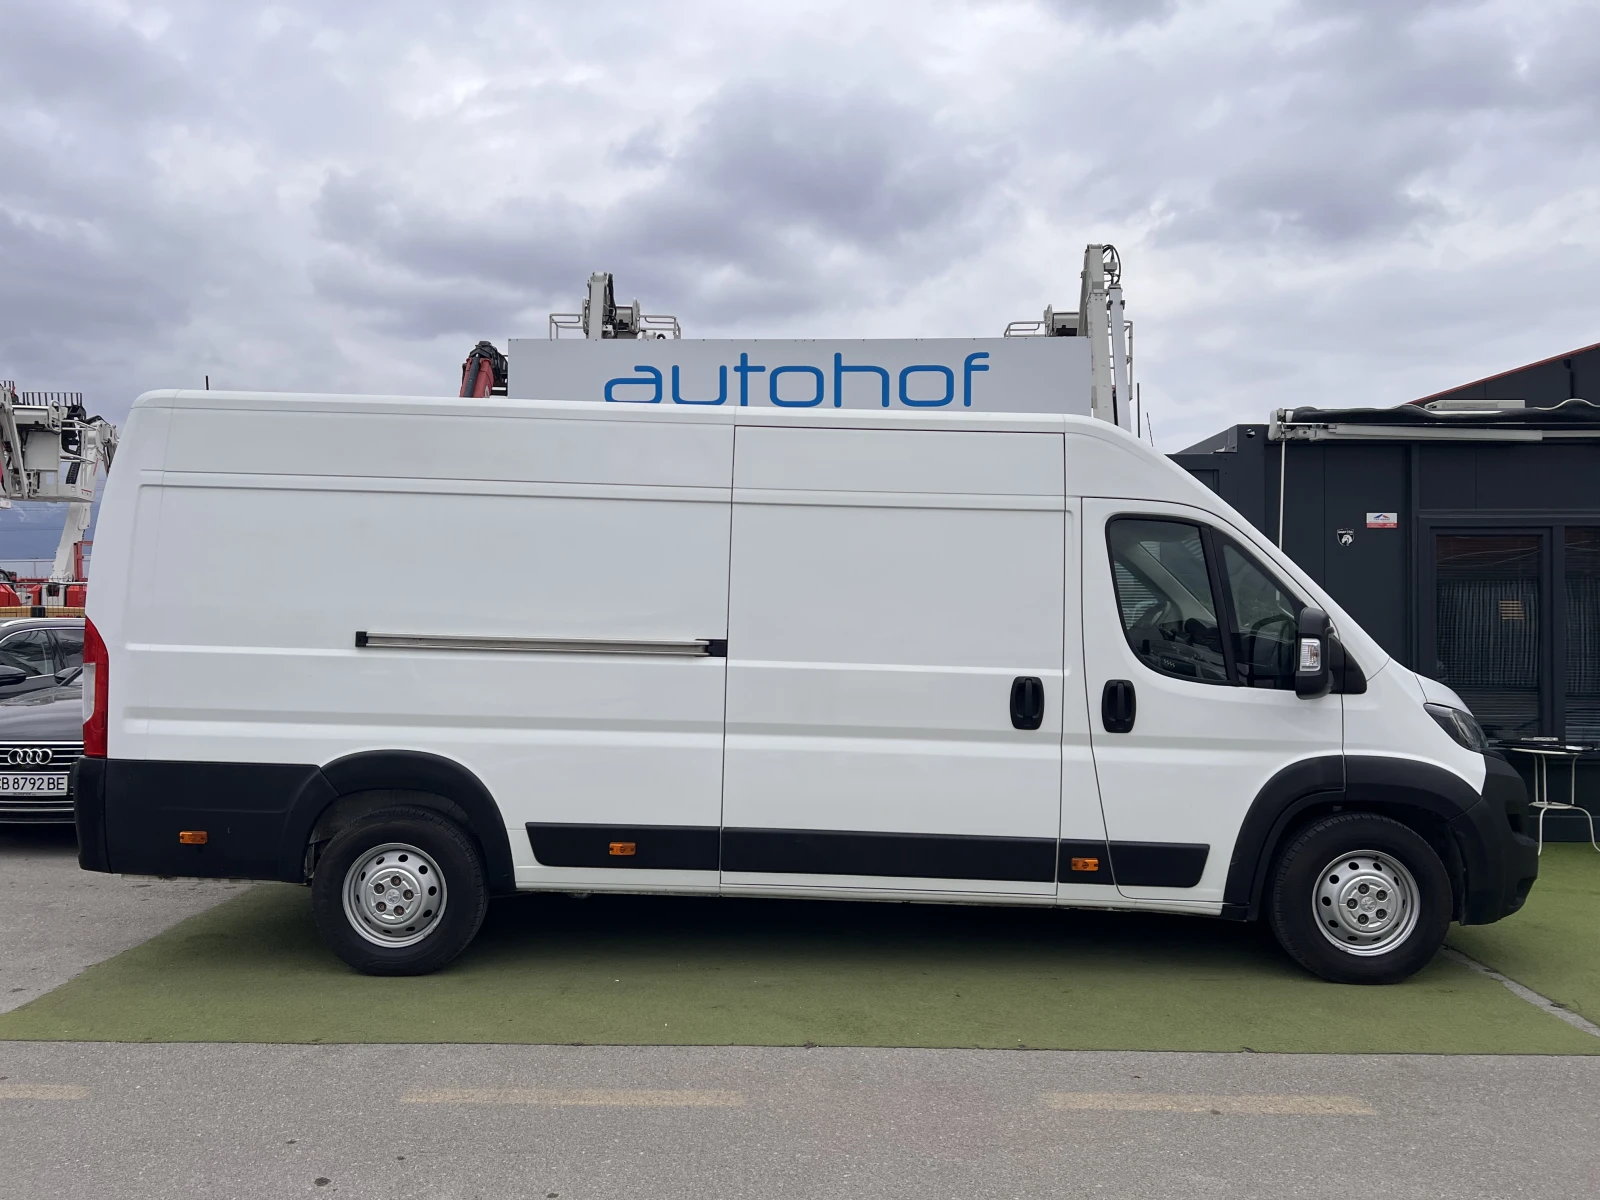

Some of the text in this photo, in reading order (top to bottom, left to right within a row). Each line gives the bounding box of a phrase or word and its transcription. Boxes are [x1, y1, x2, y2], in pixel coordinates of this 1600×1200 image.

[604, 352, 990, 408] autohof
[0, 777, 65, 791] B 8792 BE
